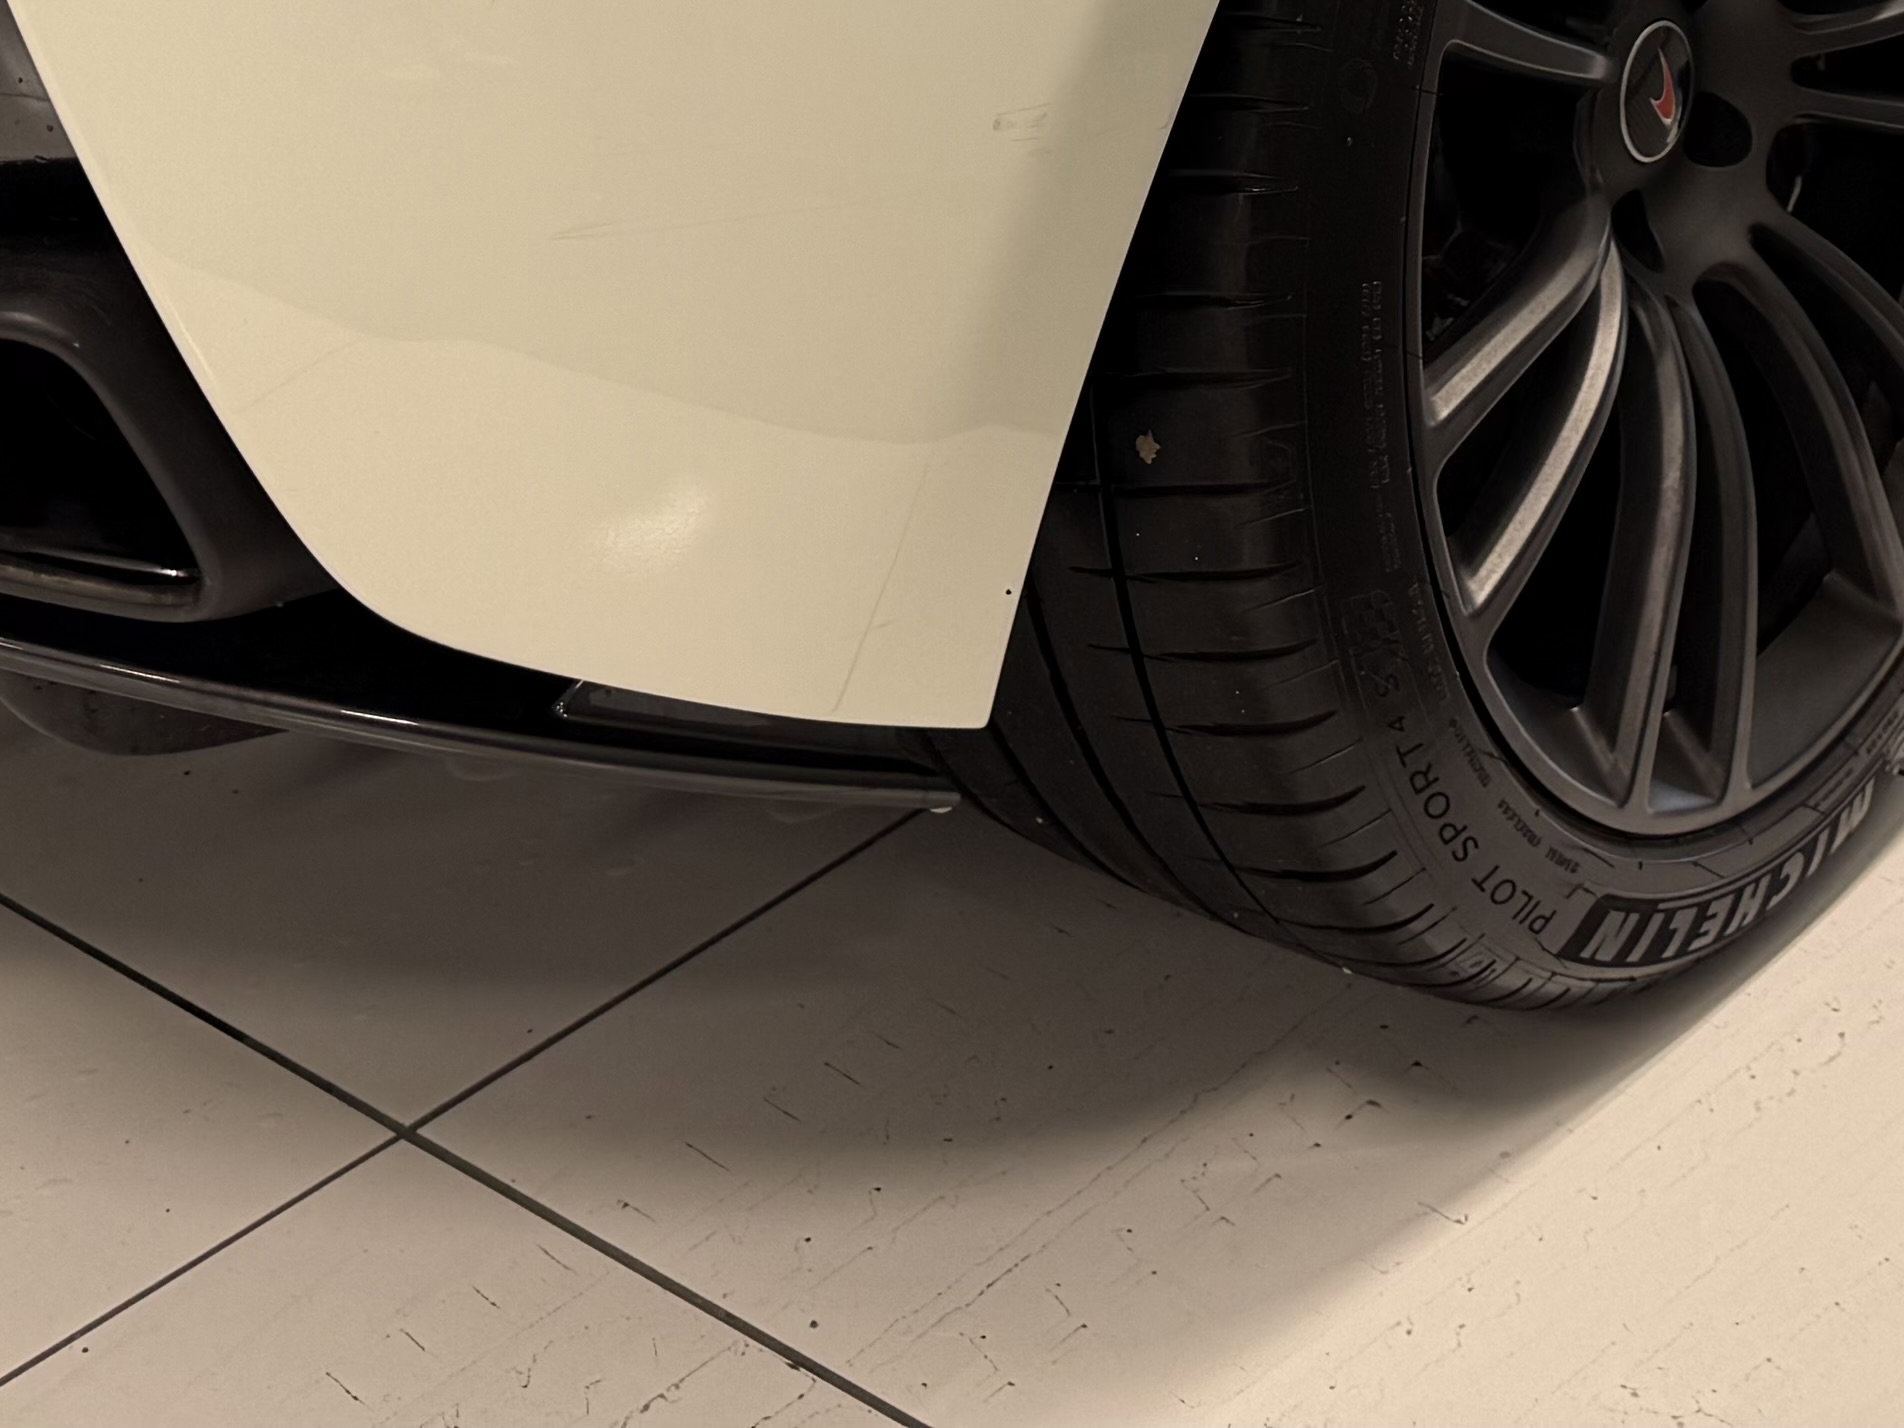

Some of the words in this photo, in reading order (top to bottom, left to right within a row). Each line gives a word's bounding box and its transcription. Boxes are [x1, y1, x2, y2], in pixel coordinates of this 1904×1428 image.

[1396, 743, 1479, 863] SPORT
[1472, 864, 1556, 936] PILOT
[1582, 776, 1876, 963] MICHELIN
